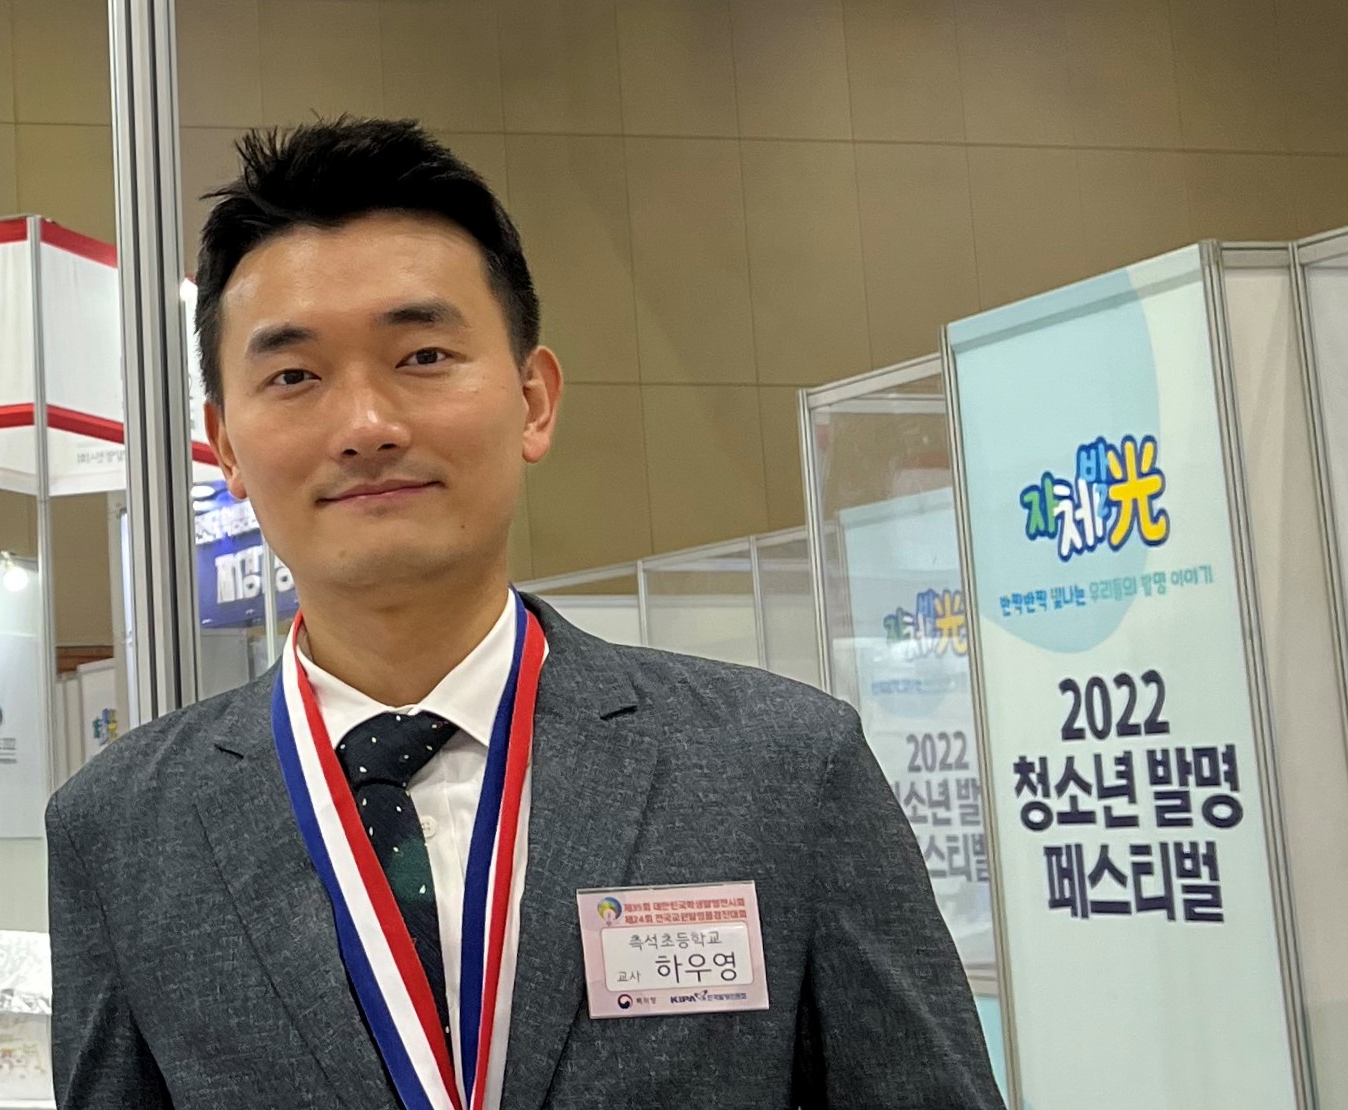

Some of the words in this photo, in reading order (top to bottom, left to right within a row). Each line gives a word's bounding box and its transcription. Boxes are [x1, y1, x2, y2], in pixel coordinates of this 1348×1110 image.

[1058, 669, 1171, 742] 2022
[906, 731, 970, 773] 2022
[896, 779, 950, 827] 소년
[1012, 750, 1140, 832] 청소년
[1145, 743, 1244, 829] 발명
[918, 833, 990, 883] 스티벌
[1042, 841, 1225, 923] 페스티벌
[629, 931, 722, 950] 촉석초등학교
[617, 971, 640, 983] 교사
[655, 951, 738, 984] 하우영
